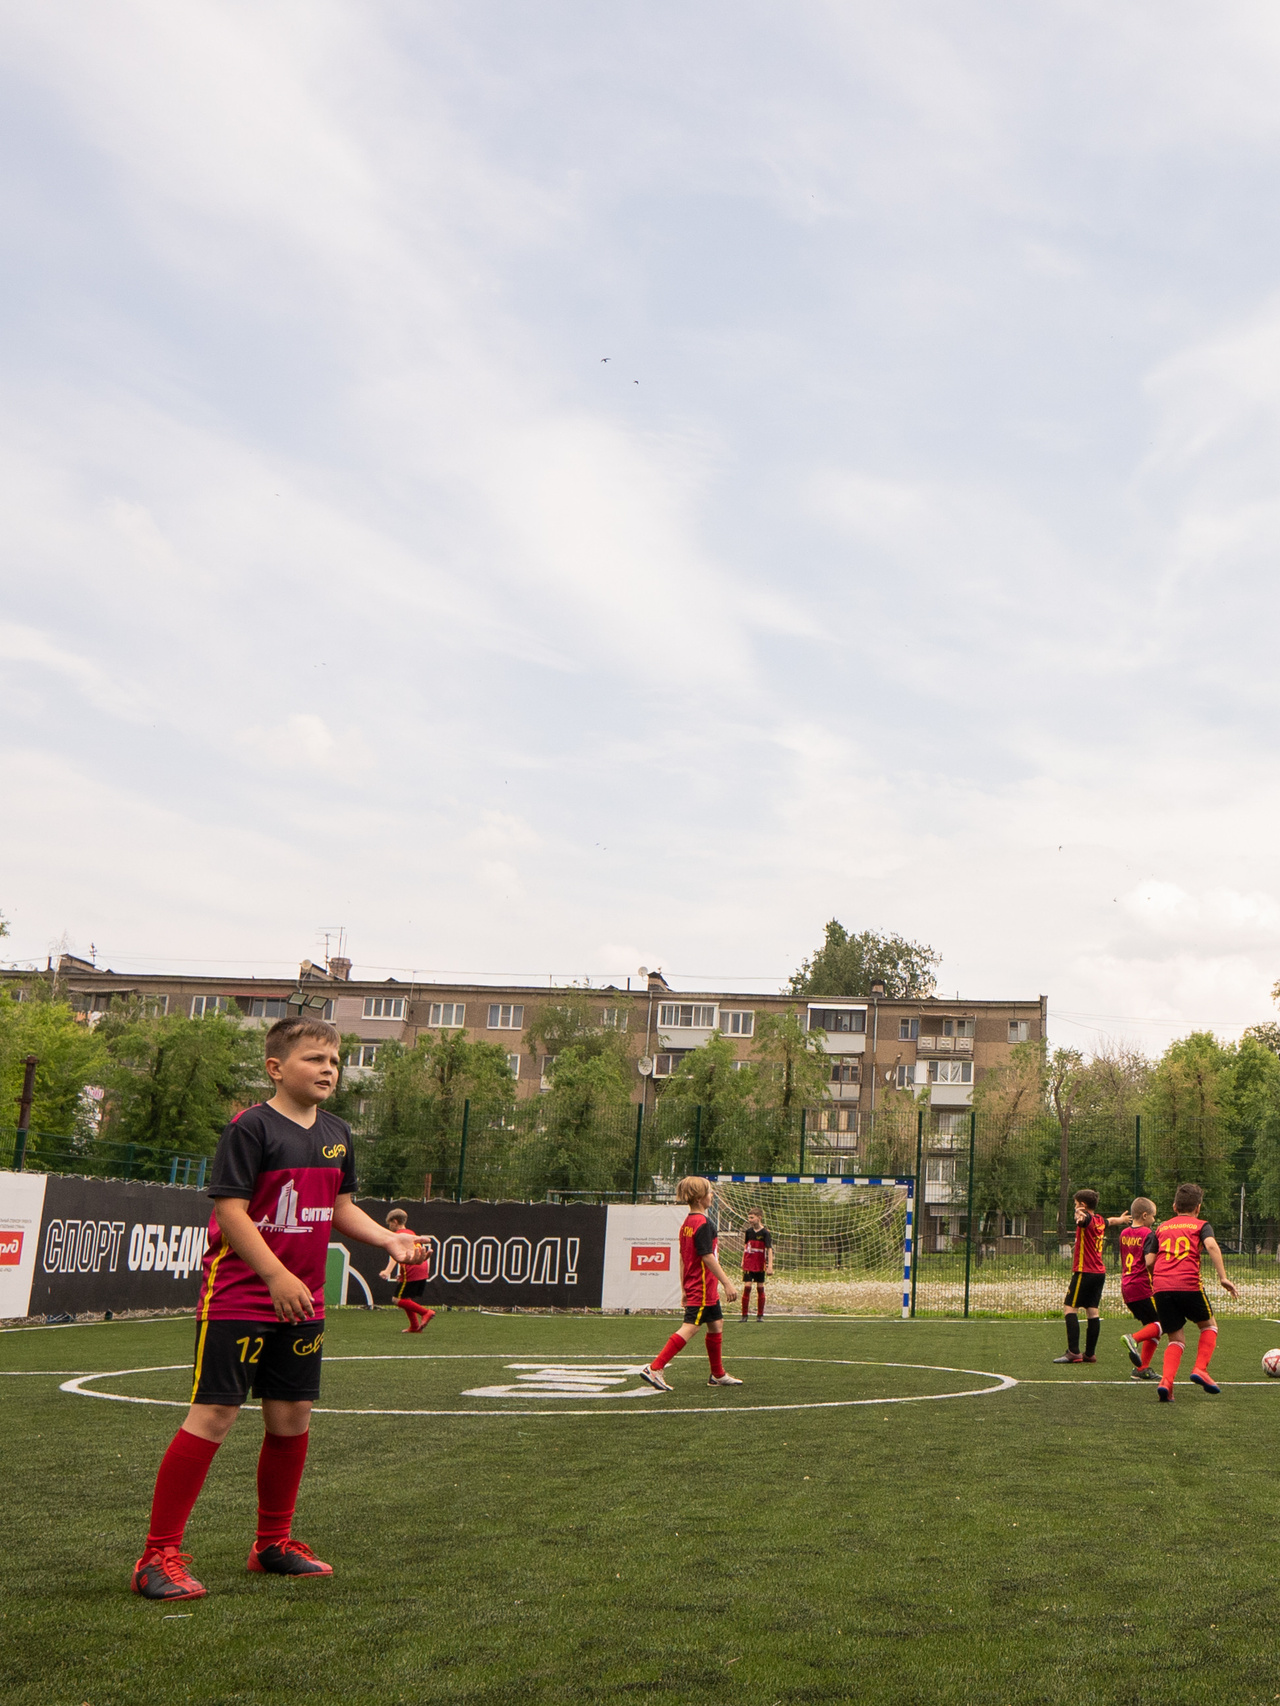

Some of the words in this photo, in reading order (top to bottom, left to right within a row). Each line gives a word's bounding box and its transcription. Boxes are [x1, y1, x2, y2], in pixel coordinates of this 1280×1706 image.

[43, 1219, 125, 1273] СПОРТ
[1160, 1236, 1191, 1261] 10
[1125, 1252, 1135, 1275] 9
[236, 1336, 264, 1363] 12
